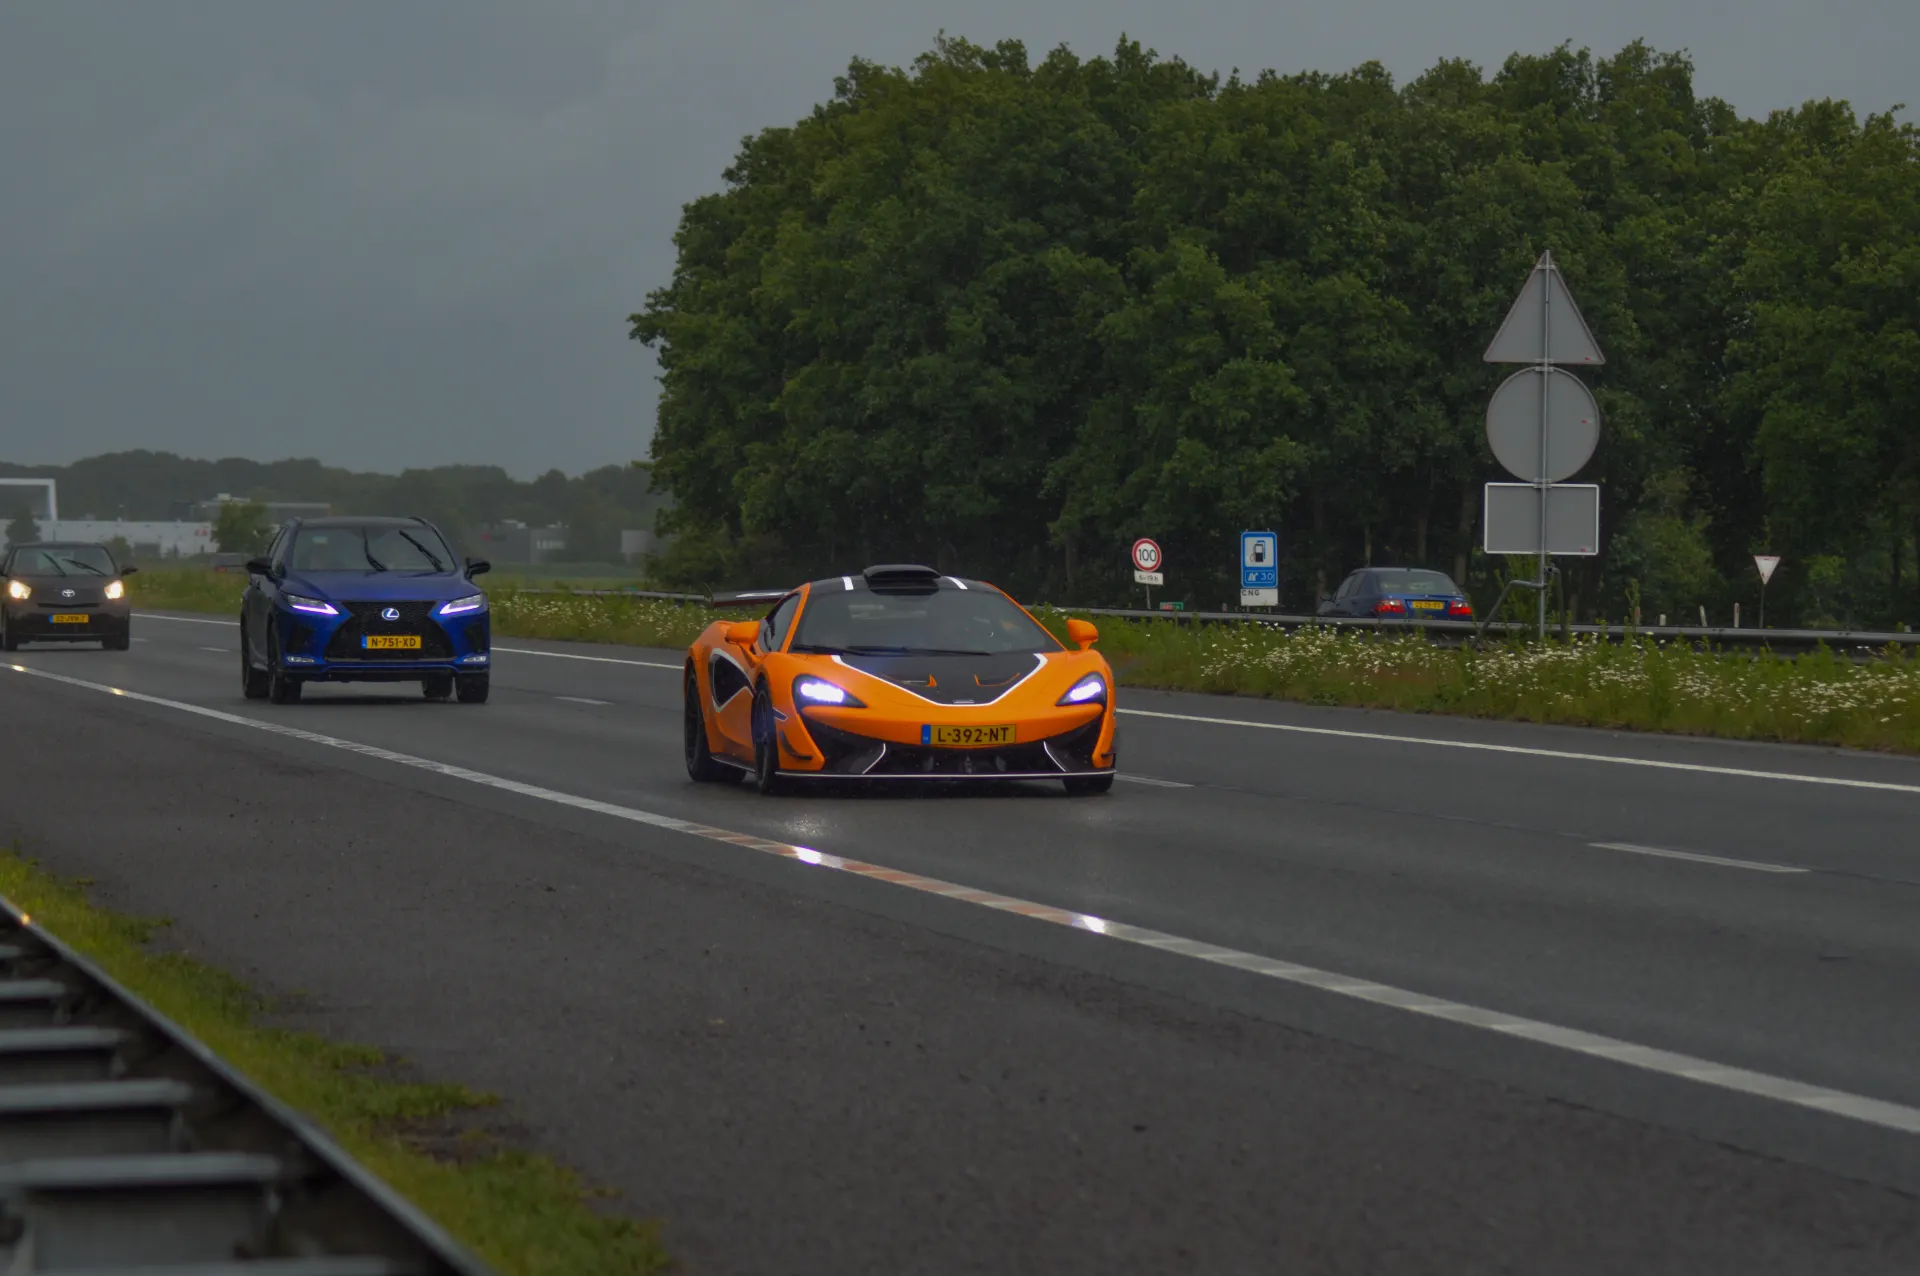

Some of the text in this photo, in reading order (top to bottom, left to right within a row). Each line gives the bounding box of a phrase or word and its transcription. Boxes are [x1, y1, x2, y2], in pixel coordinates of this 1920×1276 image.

[1138, 548, 1157, 562] 100
[1260, 572, 1274, 581] 30
[1241, 589, 1260, 597] CNG
[371, 637, 416, 647] N-751-XD
[937, 727, 1009, 743] L-392-NT
